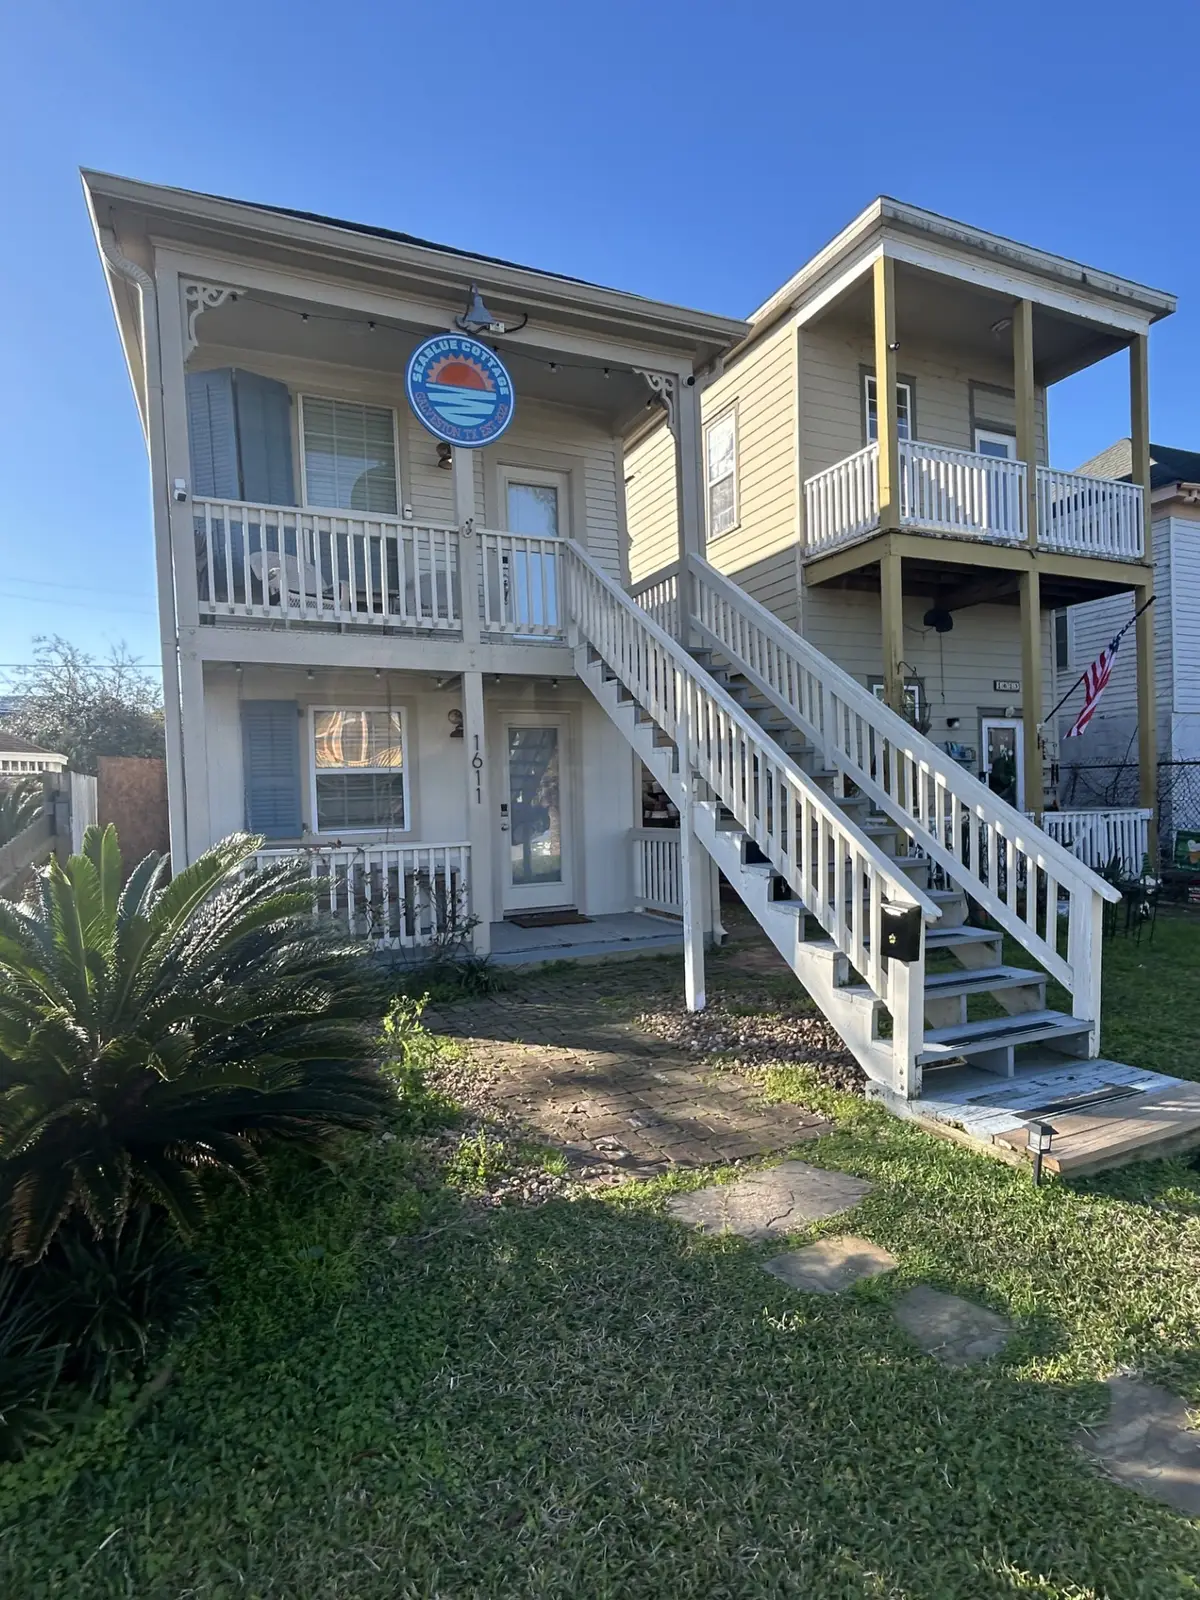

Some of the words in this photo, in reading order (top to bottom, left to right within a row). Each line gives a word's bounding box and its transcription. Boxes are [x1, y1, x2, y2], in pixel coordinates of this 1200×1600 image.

[412, 339, 459, 383] SEABLUE
[461, 342, 509, 395] COTTAGE
[415, 391, 460, 438] GALVESTON
[472, 734, 483, 805] 1611
